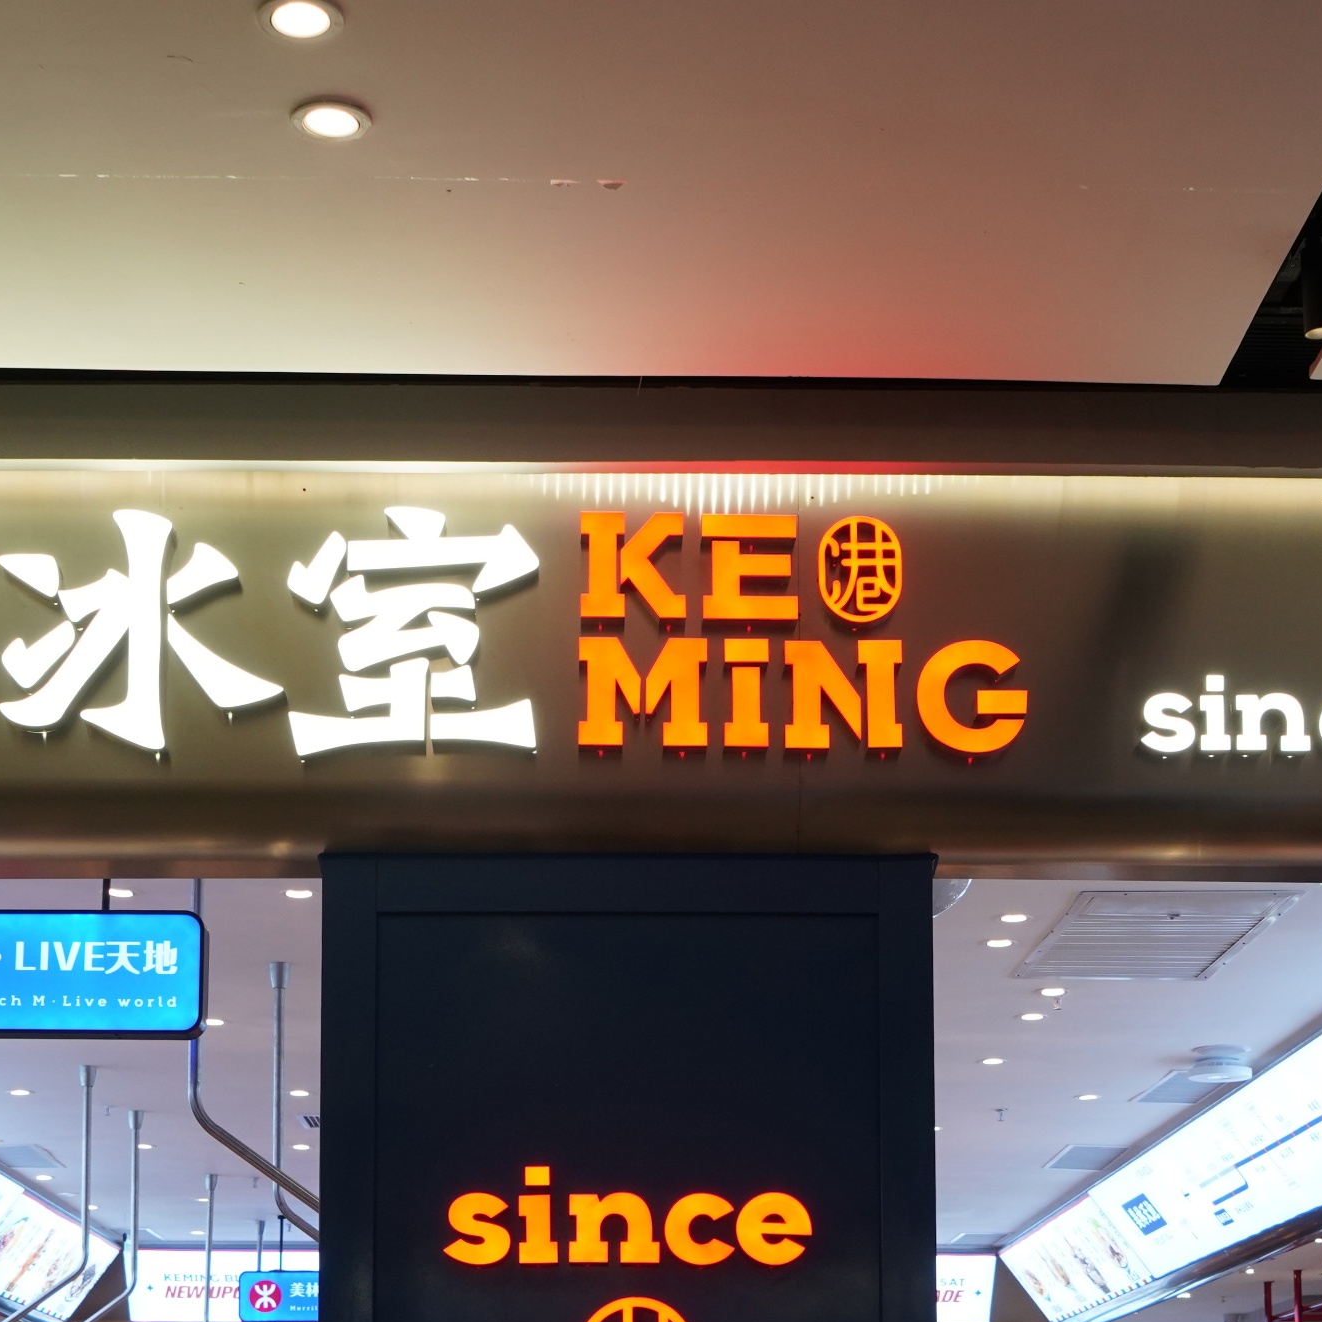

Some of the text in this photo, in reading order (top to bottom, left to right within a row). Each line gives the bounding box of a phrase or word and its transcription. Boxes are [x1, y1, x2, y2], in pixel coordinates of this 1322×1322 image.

[580, 510, 800, 622] KE
[818, 516, 904, 623] 港
[117, 994, 178, 1009] world
[442, 1165, 813, 1266] since
[165, 1285, 206, 1299] NEW
[940, 1278, 966, 1287] SAT
